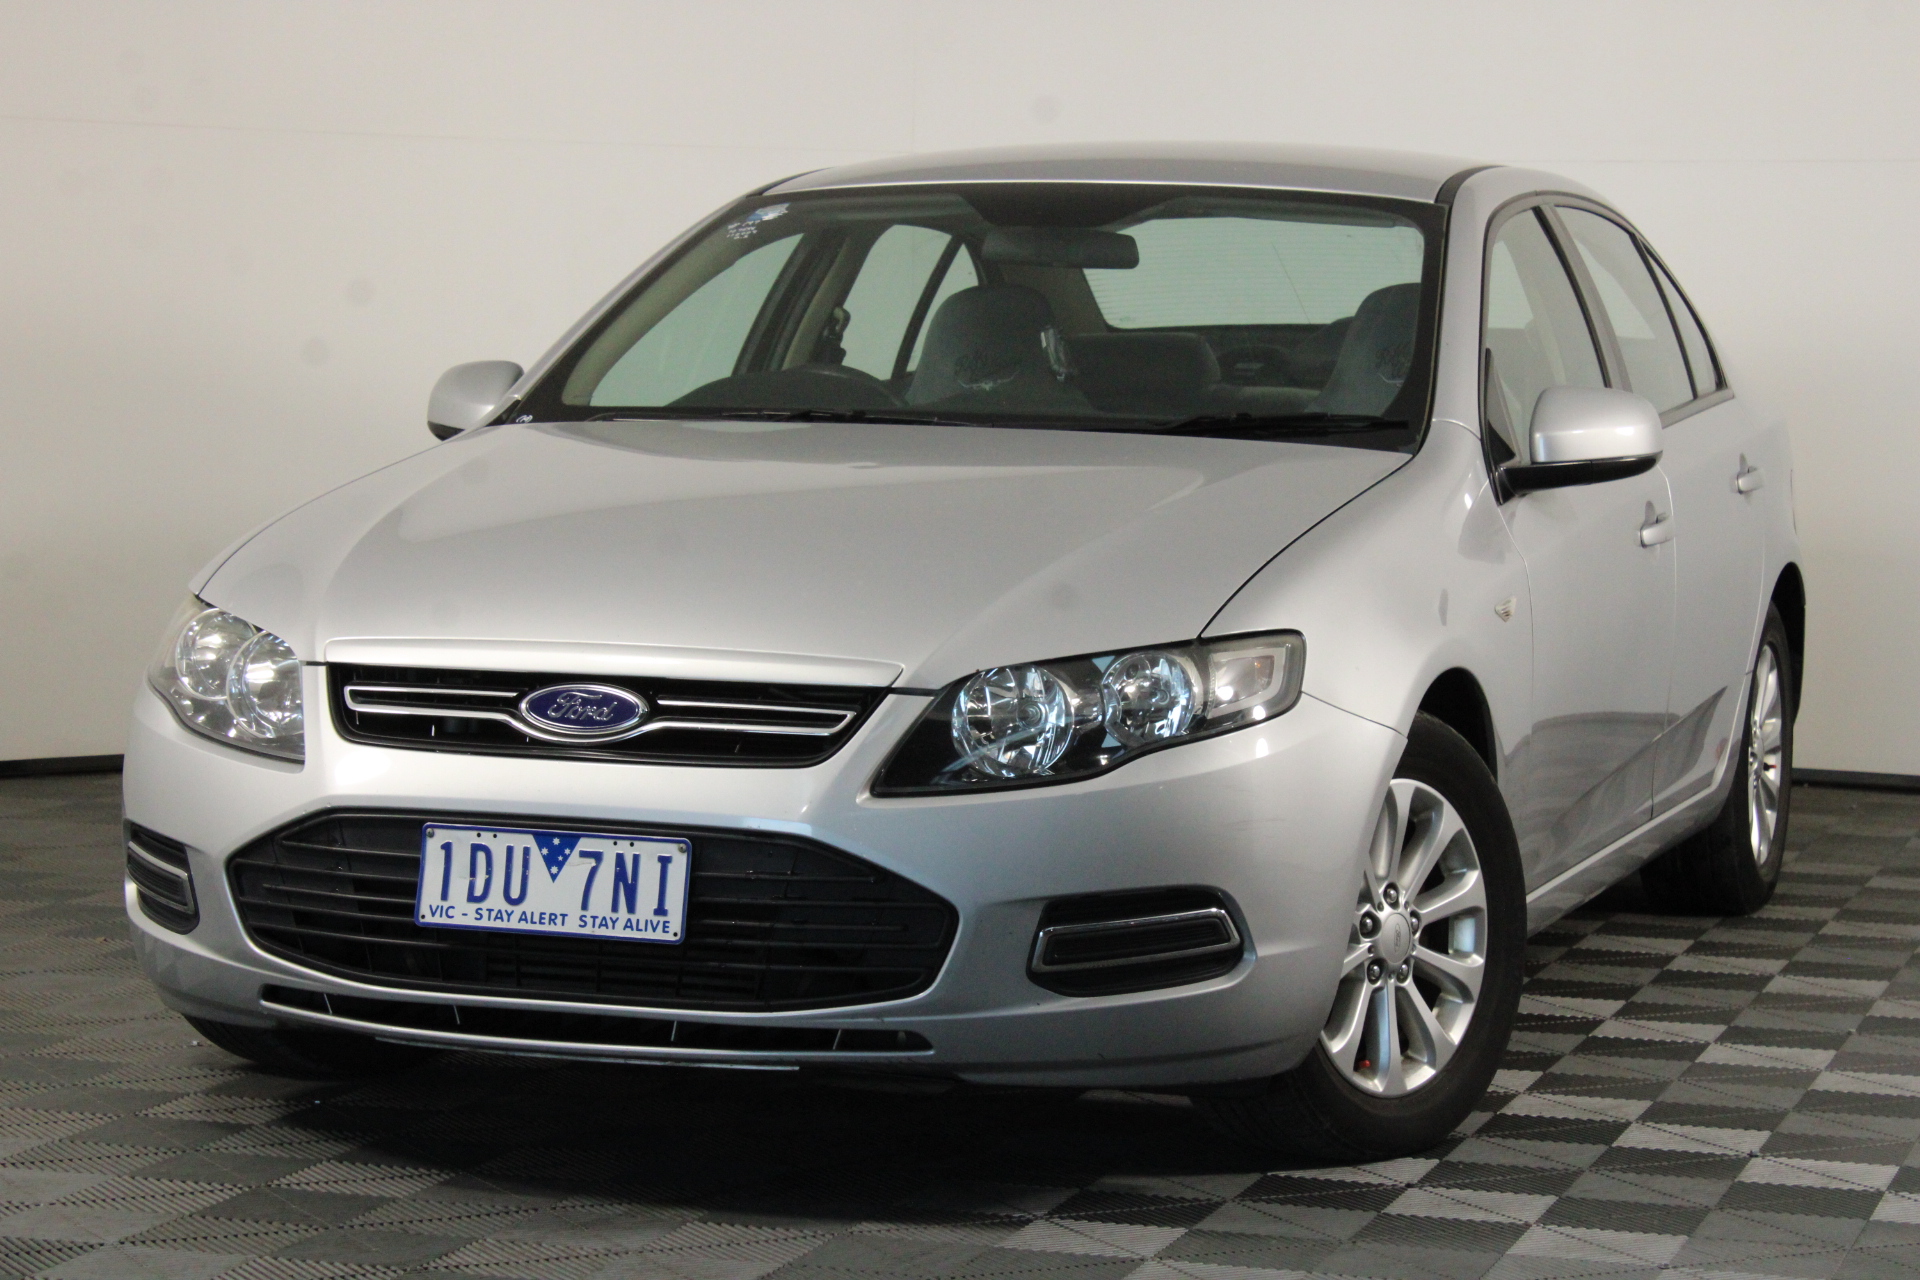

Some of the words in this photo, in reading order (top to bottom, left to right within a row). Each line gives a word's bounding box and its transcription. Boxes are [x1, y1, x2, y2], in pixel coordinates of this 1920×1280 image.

[547, 691, 617, 720] Ford
[440, 840, 531, 906] 1DU
[578, 849, 673, 917] 7NI
[428, 904, 456, 919] VIC
[474, 907, 515, 923] STAY
[518, 910, 568, 927] ALERT
[578, 914, 620, 930] STAY
[623, 918, 671, 934] ALIVE
